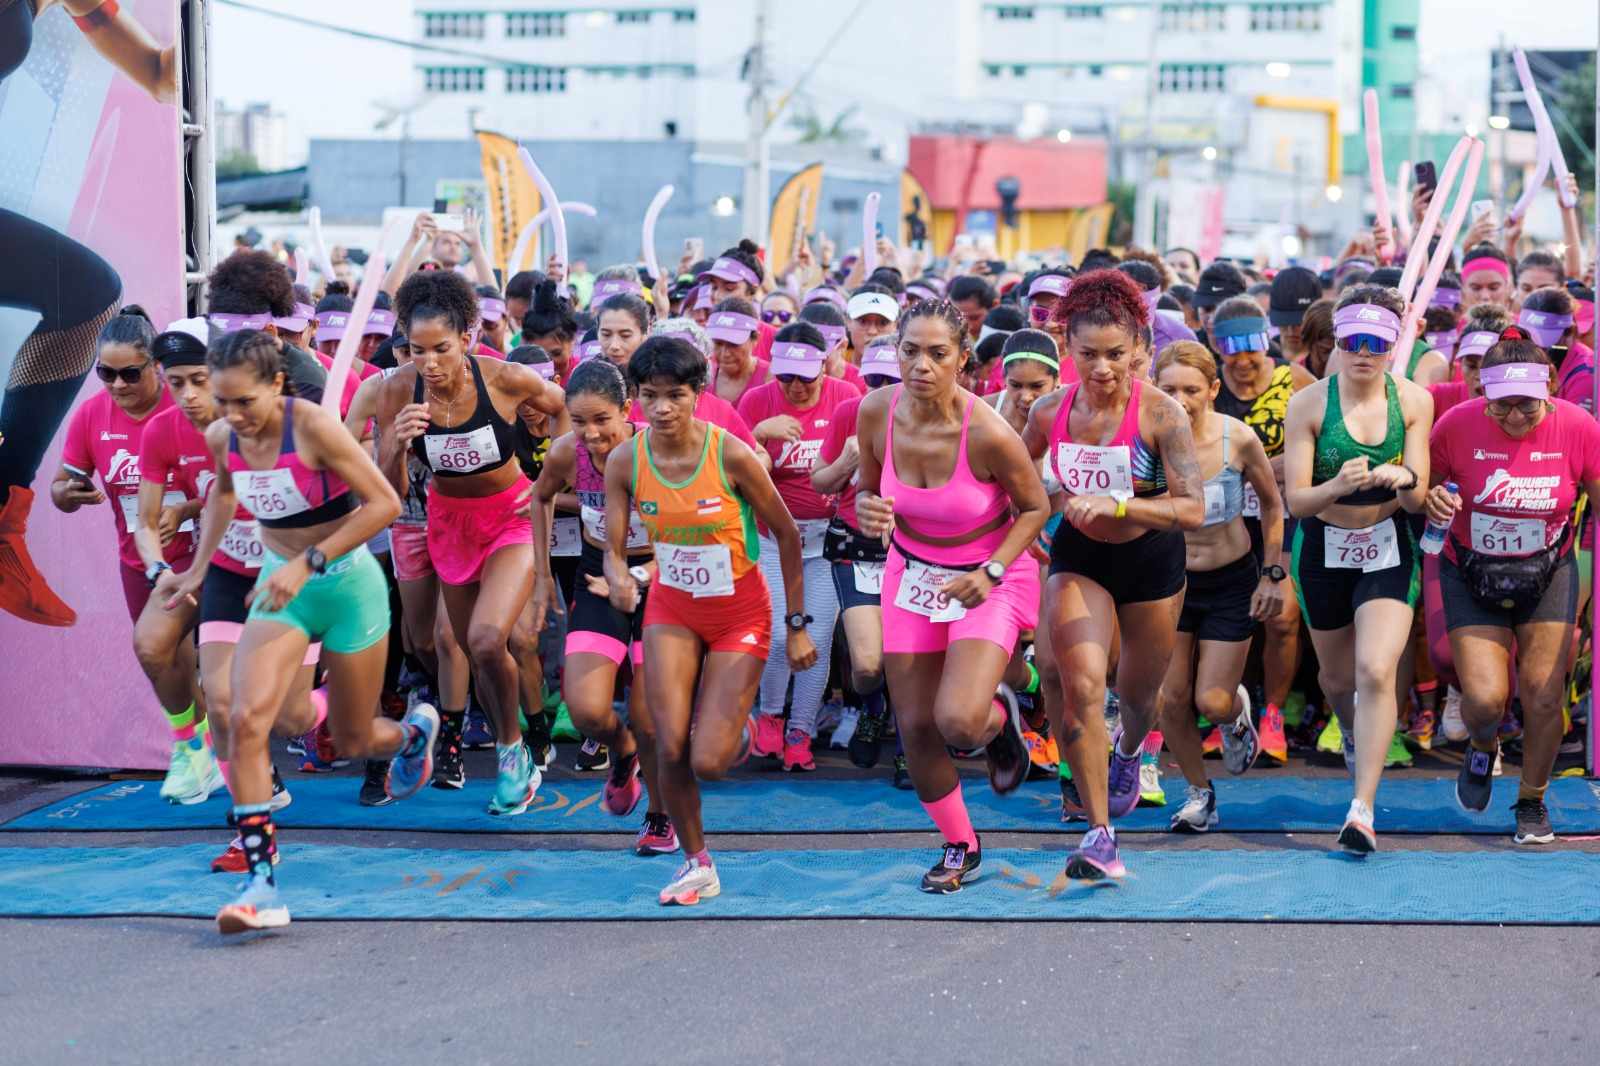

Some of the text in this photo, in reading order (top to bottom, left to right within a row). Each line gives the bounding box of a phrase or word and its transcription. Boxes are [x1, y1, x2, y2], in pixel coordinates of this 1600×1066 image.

[439, 450, 481, 468] 868
[1068, 468, 1111, 489] 370
[247, 492, 287, 513] 786
[1504, 487, 1552, 500] LARGAM
[1519, 498, 1559, 511] FRENTE
[1482, 533, 1522, 552] 611
[1337, 543, 1379, 564] 736
[667, 564, 711, 586] 350
[908, 585, 951, 610] 229
